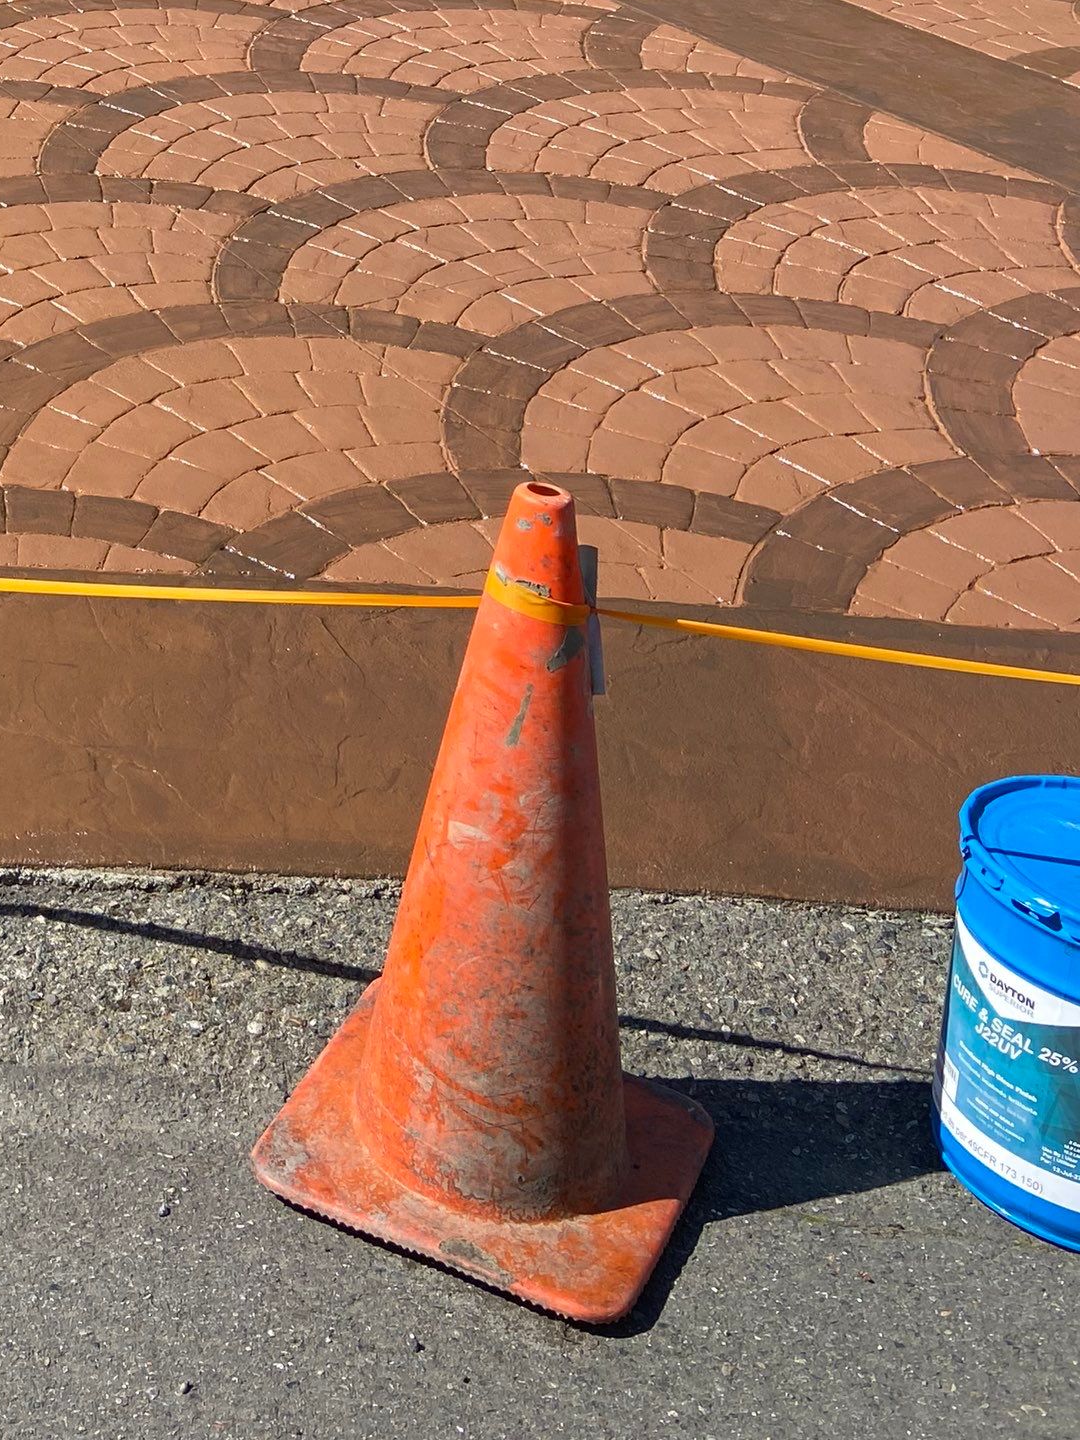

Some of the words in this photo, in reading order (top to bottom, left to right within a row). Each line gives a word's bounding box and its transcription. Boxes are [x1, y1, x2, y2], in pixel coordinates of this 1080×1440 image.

[989, 983, 1035, 1019] SUPERIOR
[990, 973, 1035, 1010] DAYTON
[953, 973, 978, 1013] CURE
[978, 1007, 988, 1023] &
[990, 1017, 1034, 1055] SEAL
[1037, 1046, 1079, 1074] 25%
[974, 1022, 1023, 1060] J22UV
[968, 1139, 997, 1167] 49CFR
